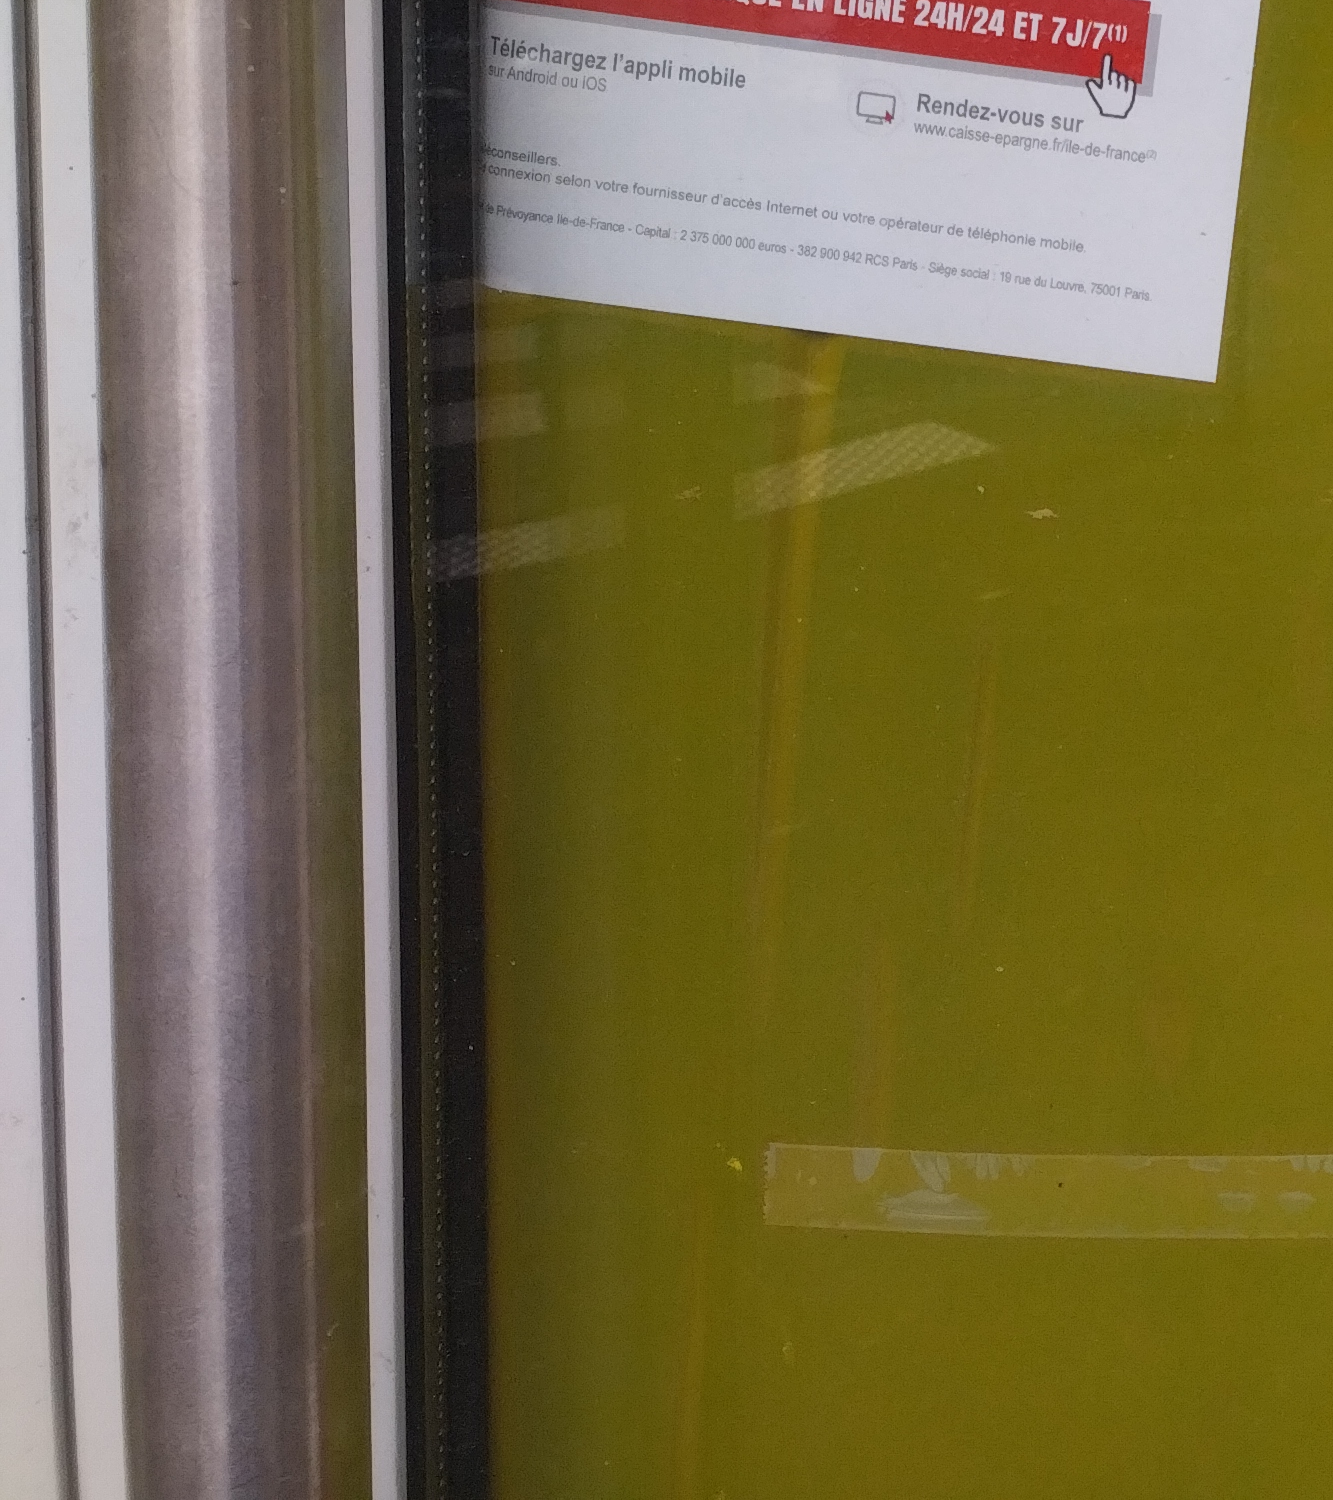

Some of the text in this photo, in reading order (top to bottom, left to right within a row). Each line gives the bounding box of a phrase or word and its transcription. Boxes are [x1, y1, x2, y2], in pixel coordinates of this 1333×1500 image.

[1013, 10, 1044, 42] ET
[487, 63, 607, 93] sur Android ou iOS
[490, 34, 746, 89] Téléchargez l'appli mobile
[916, 92, 1085, 134] Rendez-vous sur
